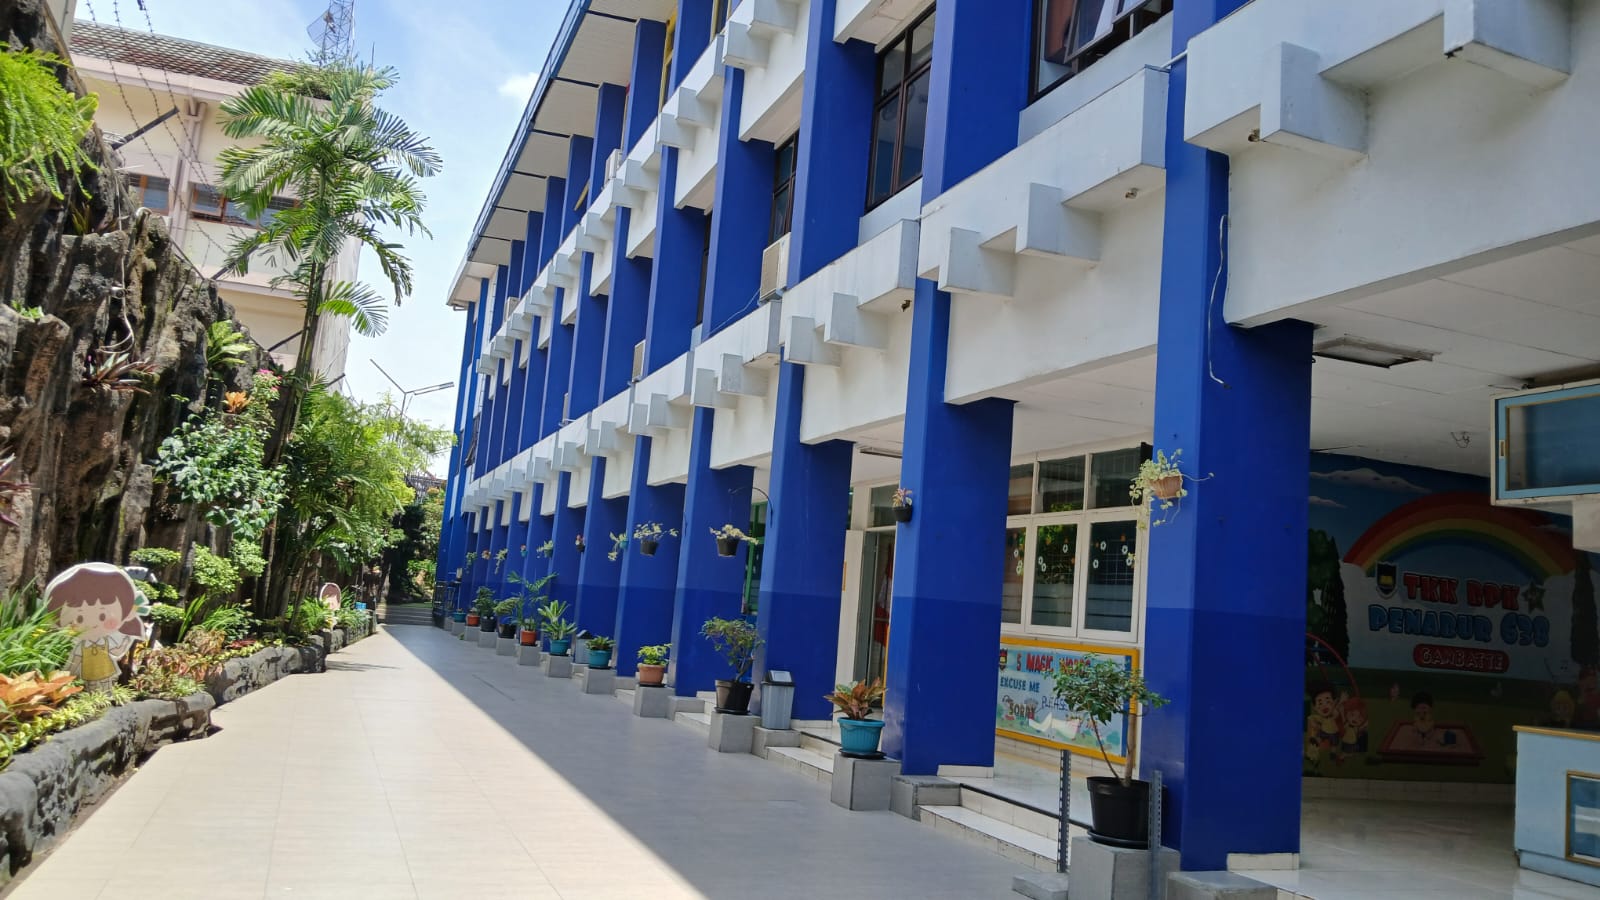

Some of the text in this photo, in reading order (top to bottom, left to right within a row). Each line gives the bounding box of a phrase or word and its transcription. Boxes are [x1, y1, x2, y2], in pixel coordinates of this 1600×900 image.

[1403, 572, 1520, 611] TKK BPK
[1368, 604, 1551, 647] PENABUR 638
[1016, 653, 1022, 671] 5
[1026, 653, 1054, 674] MAGIC
[1422, 647, 1504, 671] GAMBATTE
[1000, 676, 1041, 693] EXCUSE ME
[1008, 702, 1037, 719] SORRY
